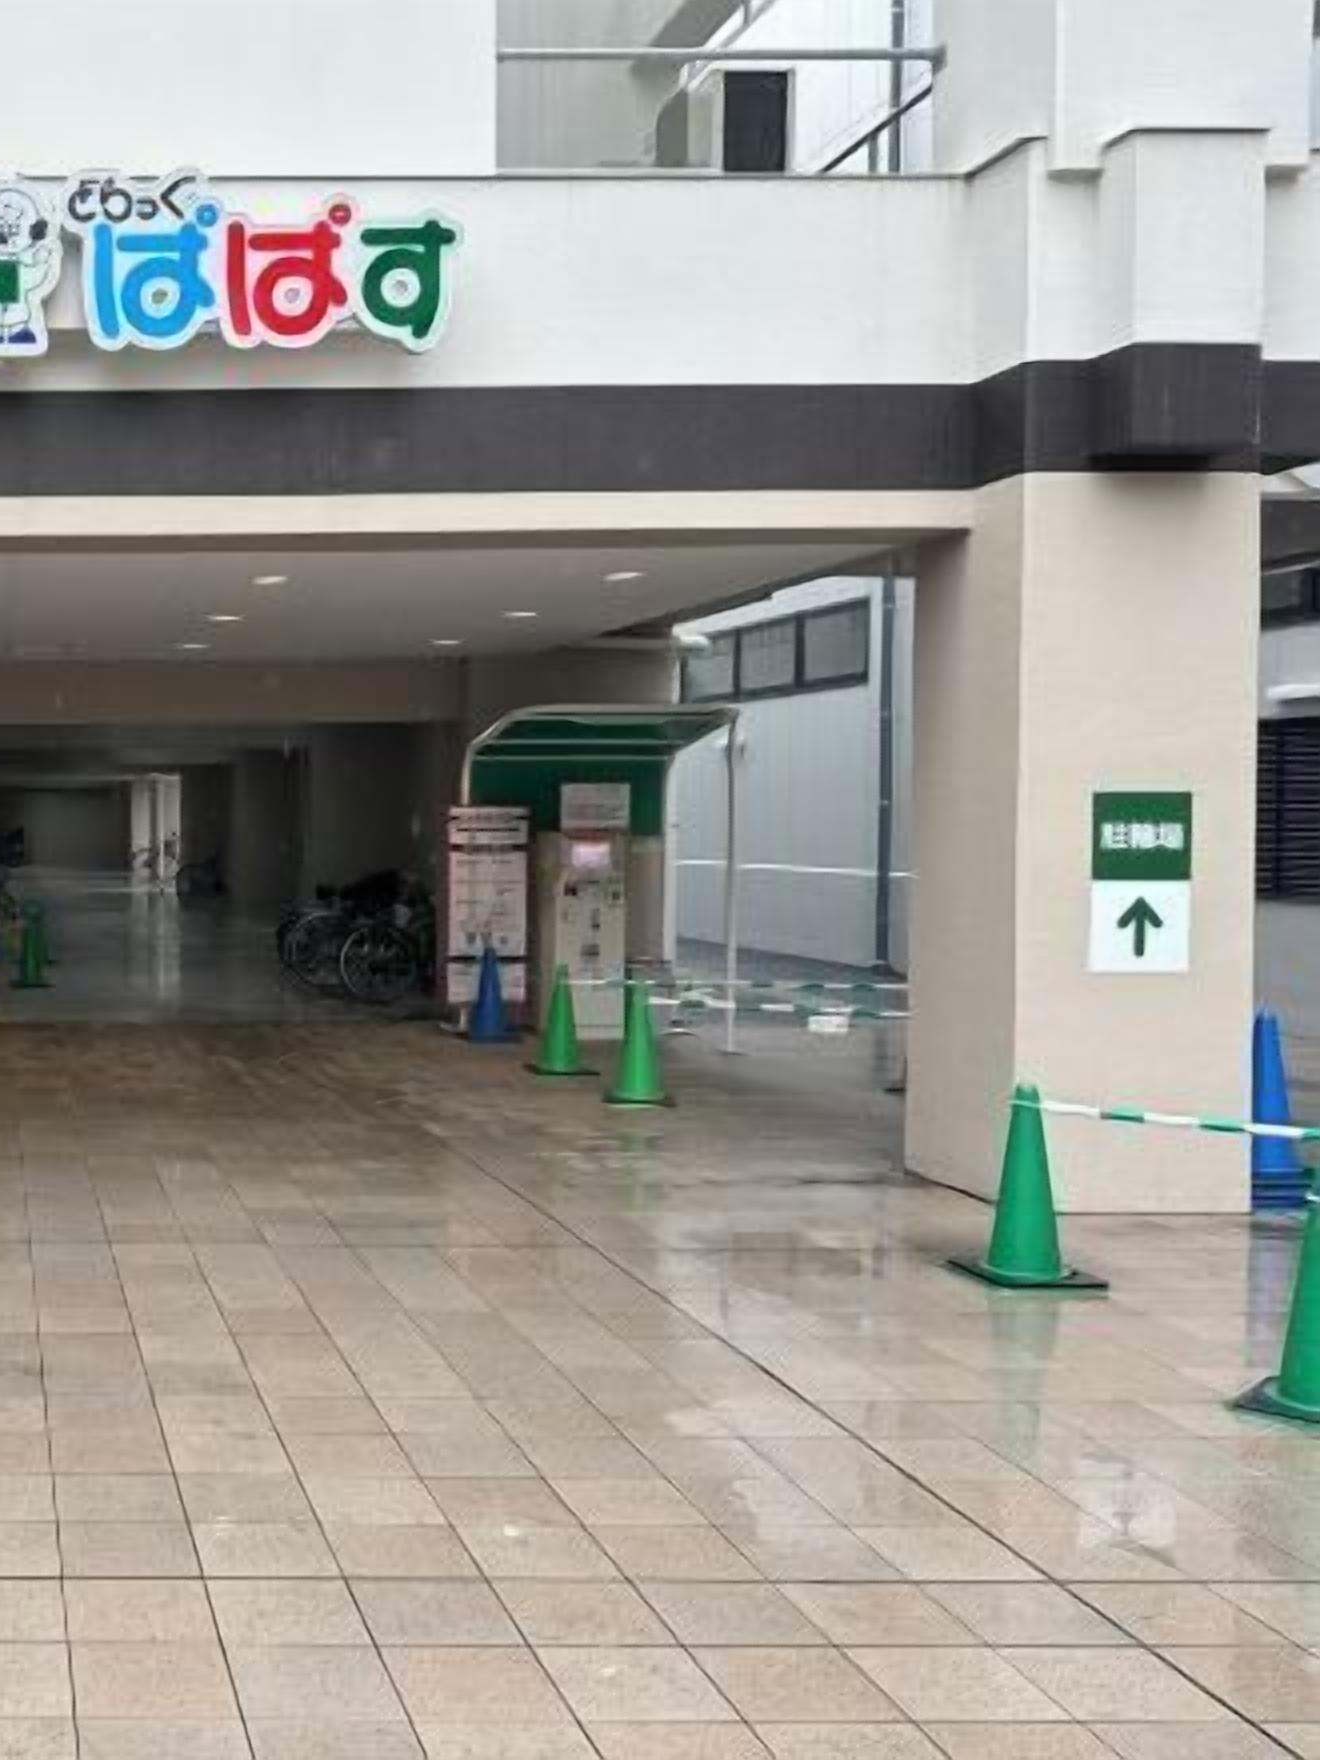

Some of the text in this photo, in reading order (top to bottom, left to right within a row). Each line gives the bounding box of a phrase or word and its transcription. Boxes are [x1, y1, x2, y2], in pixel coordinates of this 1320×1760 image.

[93, 203, 457, 340] ぱぱす
[1100, 821, 1184, 850] 駐輪場
